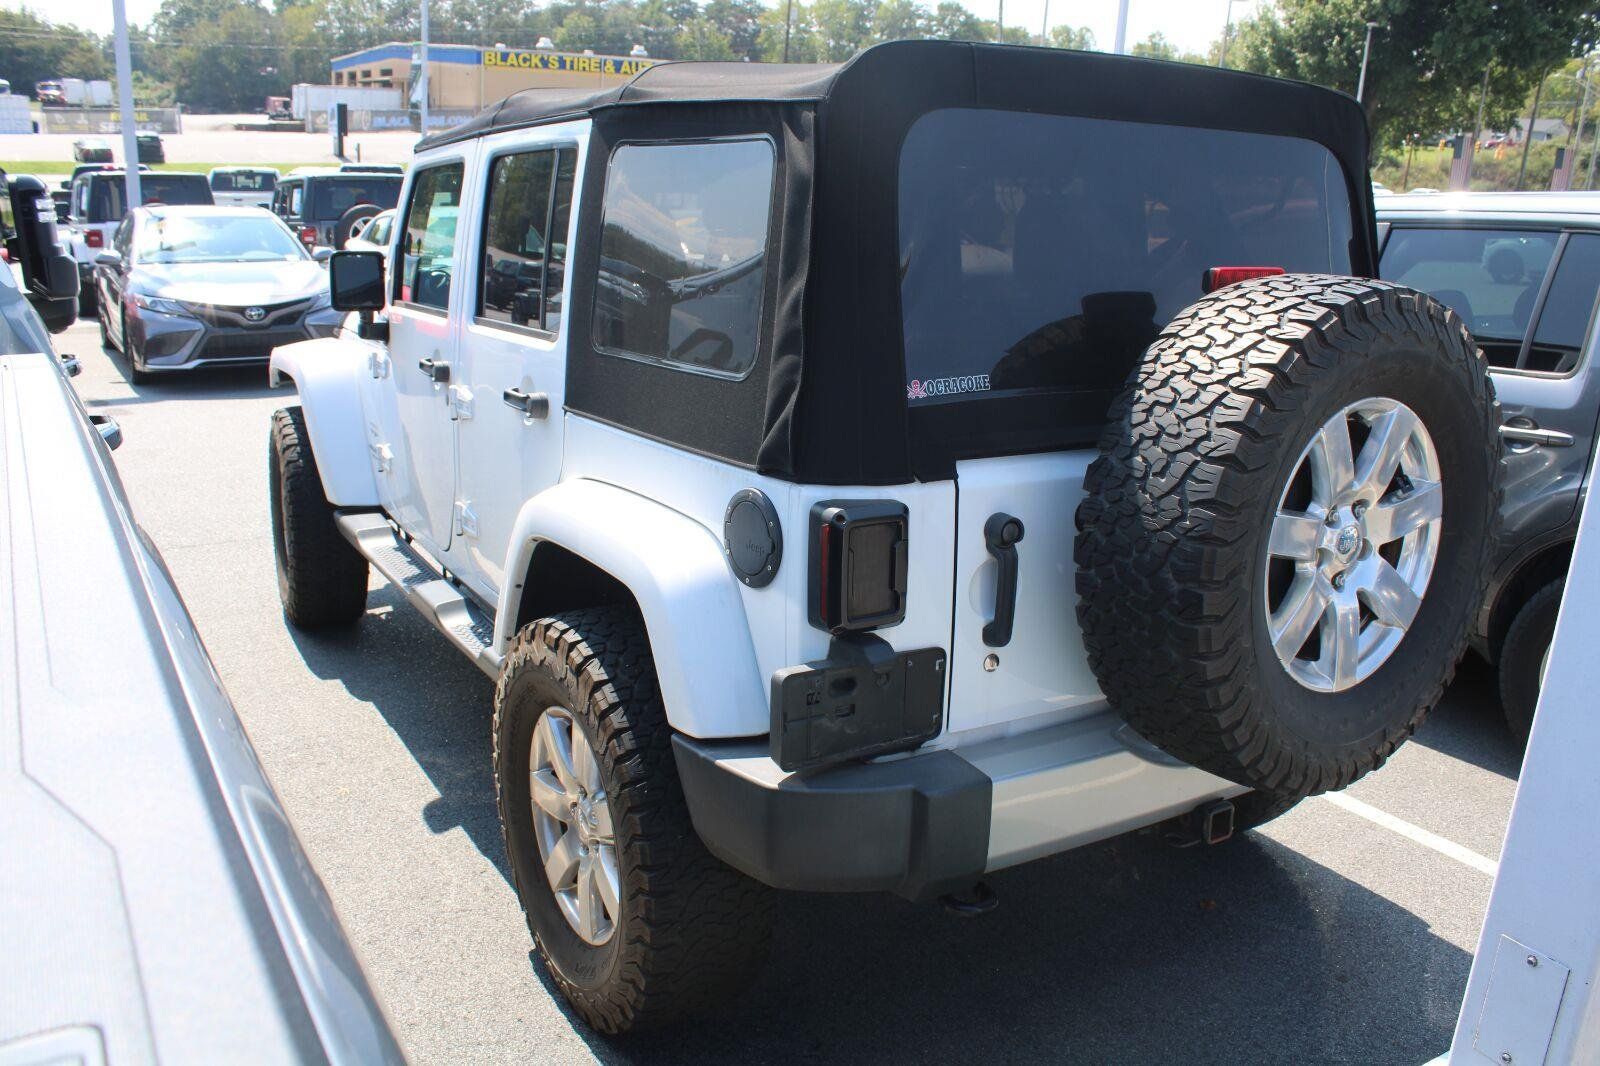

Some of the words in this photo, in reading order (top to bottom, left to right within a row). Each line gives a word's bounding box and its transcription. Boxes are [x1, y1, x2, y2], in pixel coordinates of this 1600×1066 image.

[484, 51, 559, 70] BLACK'S
[563, 56, 601, 73] TIRE
[604, 59, 615, 74] &
[926, 375, 991, 396] OCRACOKE
